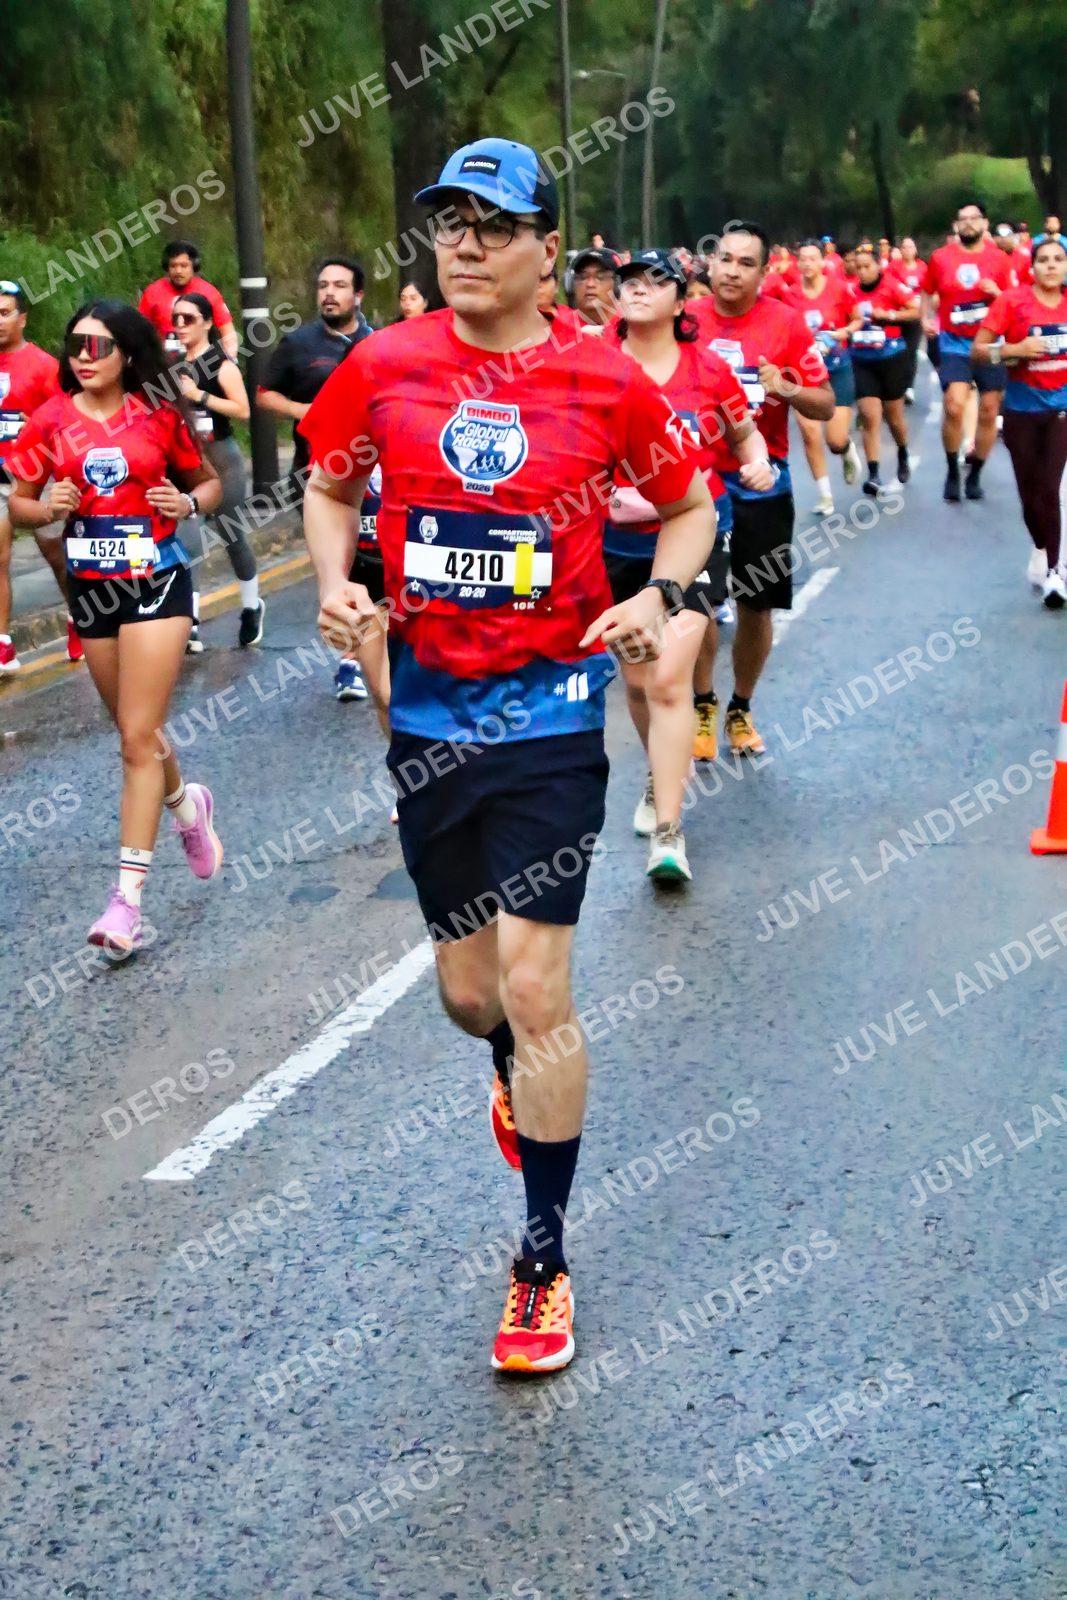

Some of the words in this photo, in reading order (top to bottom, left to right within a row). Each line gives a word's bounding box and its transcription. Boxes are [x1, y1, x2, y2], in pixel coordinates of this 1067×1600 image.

[466, 407, 511, 423] BIMBO
[465, 422, 509, 442] Global
[452, 433, 490, 451] Race
[465, 482, 491, 492] 2026
[361, 517, 376, 531] 54
[89, 540, 126, 557] 4524
[445, 551, 503, 582] 4210
[459, 586, 486, 598] 20-26
[513, 602, 535, 610] 10K
